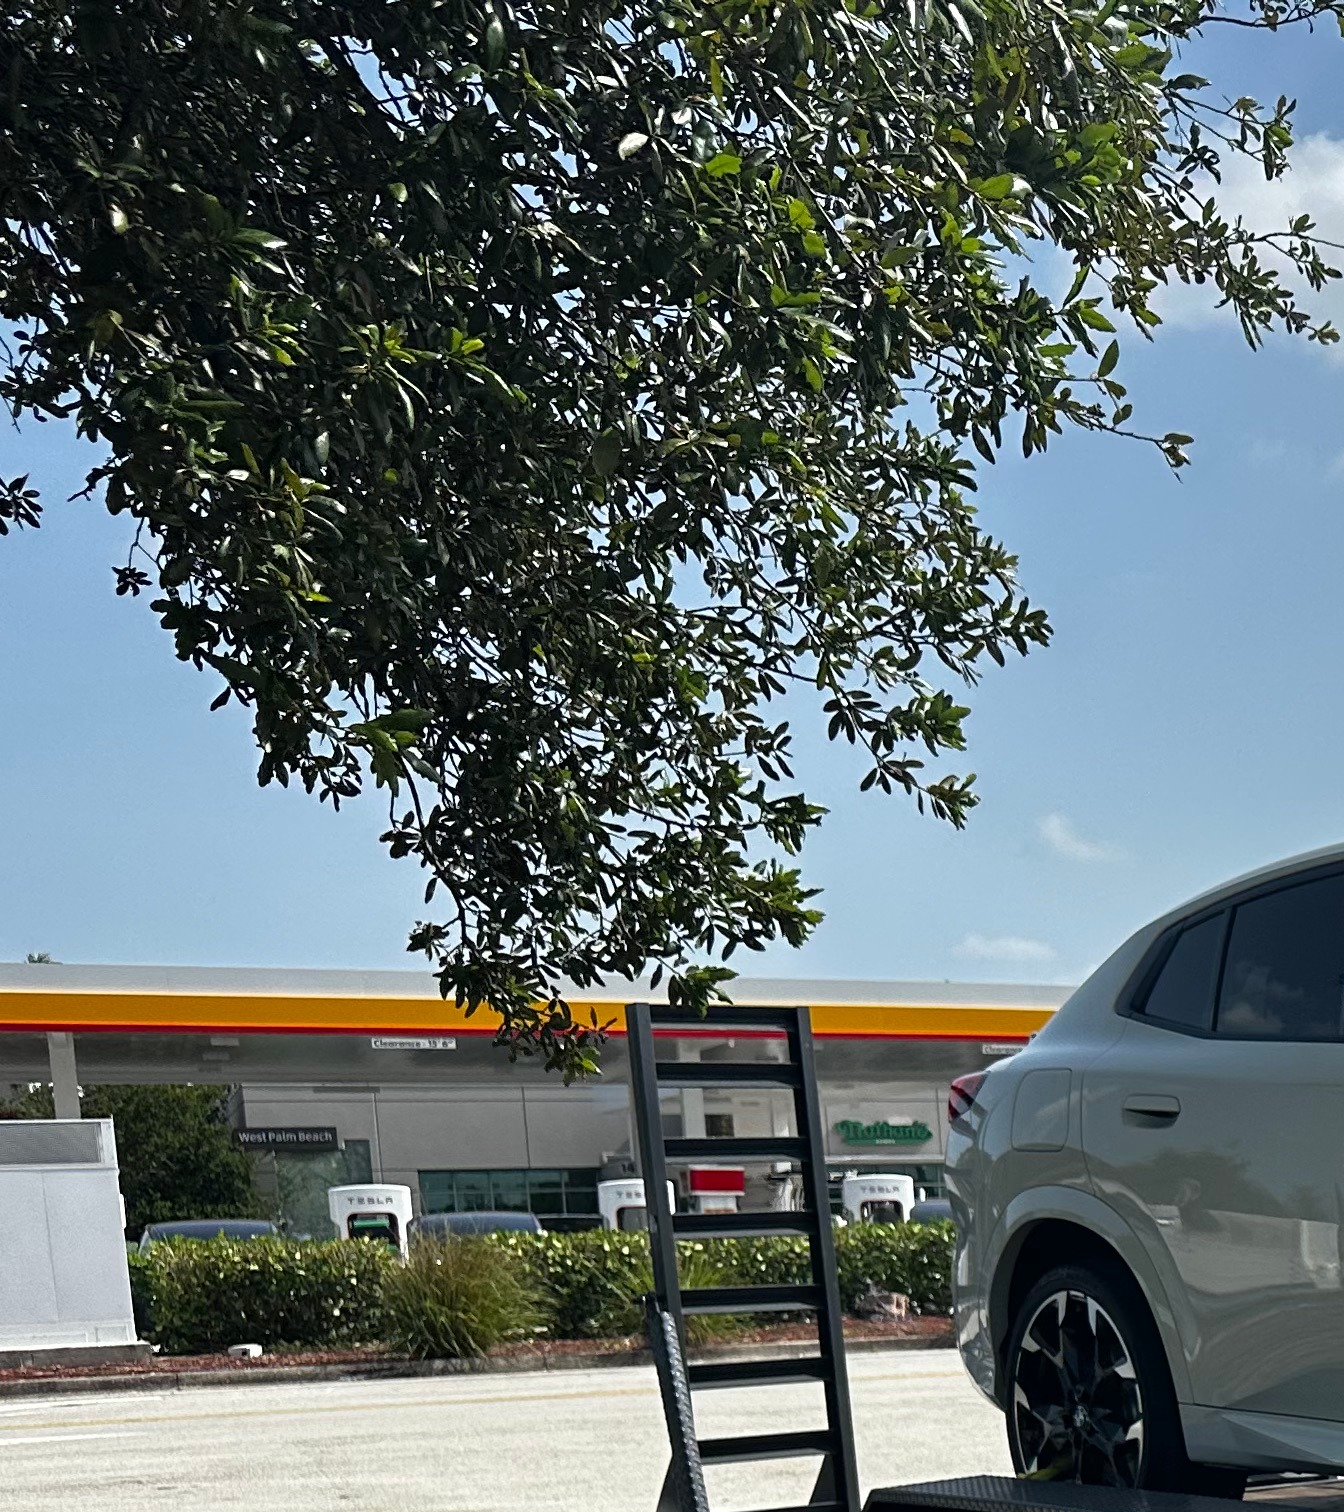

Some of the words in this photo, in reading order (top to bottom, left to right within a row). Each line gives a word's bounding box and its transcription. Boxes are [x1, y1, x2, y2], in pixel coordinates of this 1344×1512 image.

[238, 1131, 267, 1143] West
[268, 1130, 297, 1143] Palm
[298, 1130, 333, 1143] Beach
[860, 1185, 900, 1194] TESLA
[347, 1196, 394, 1206] TESLA
